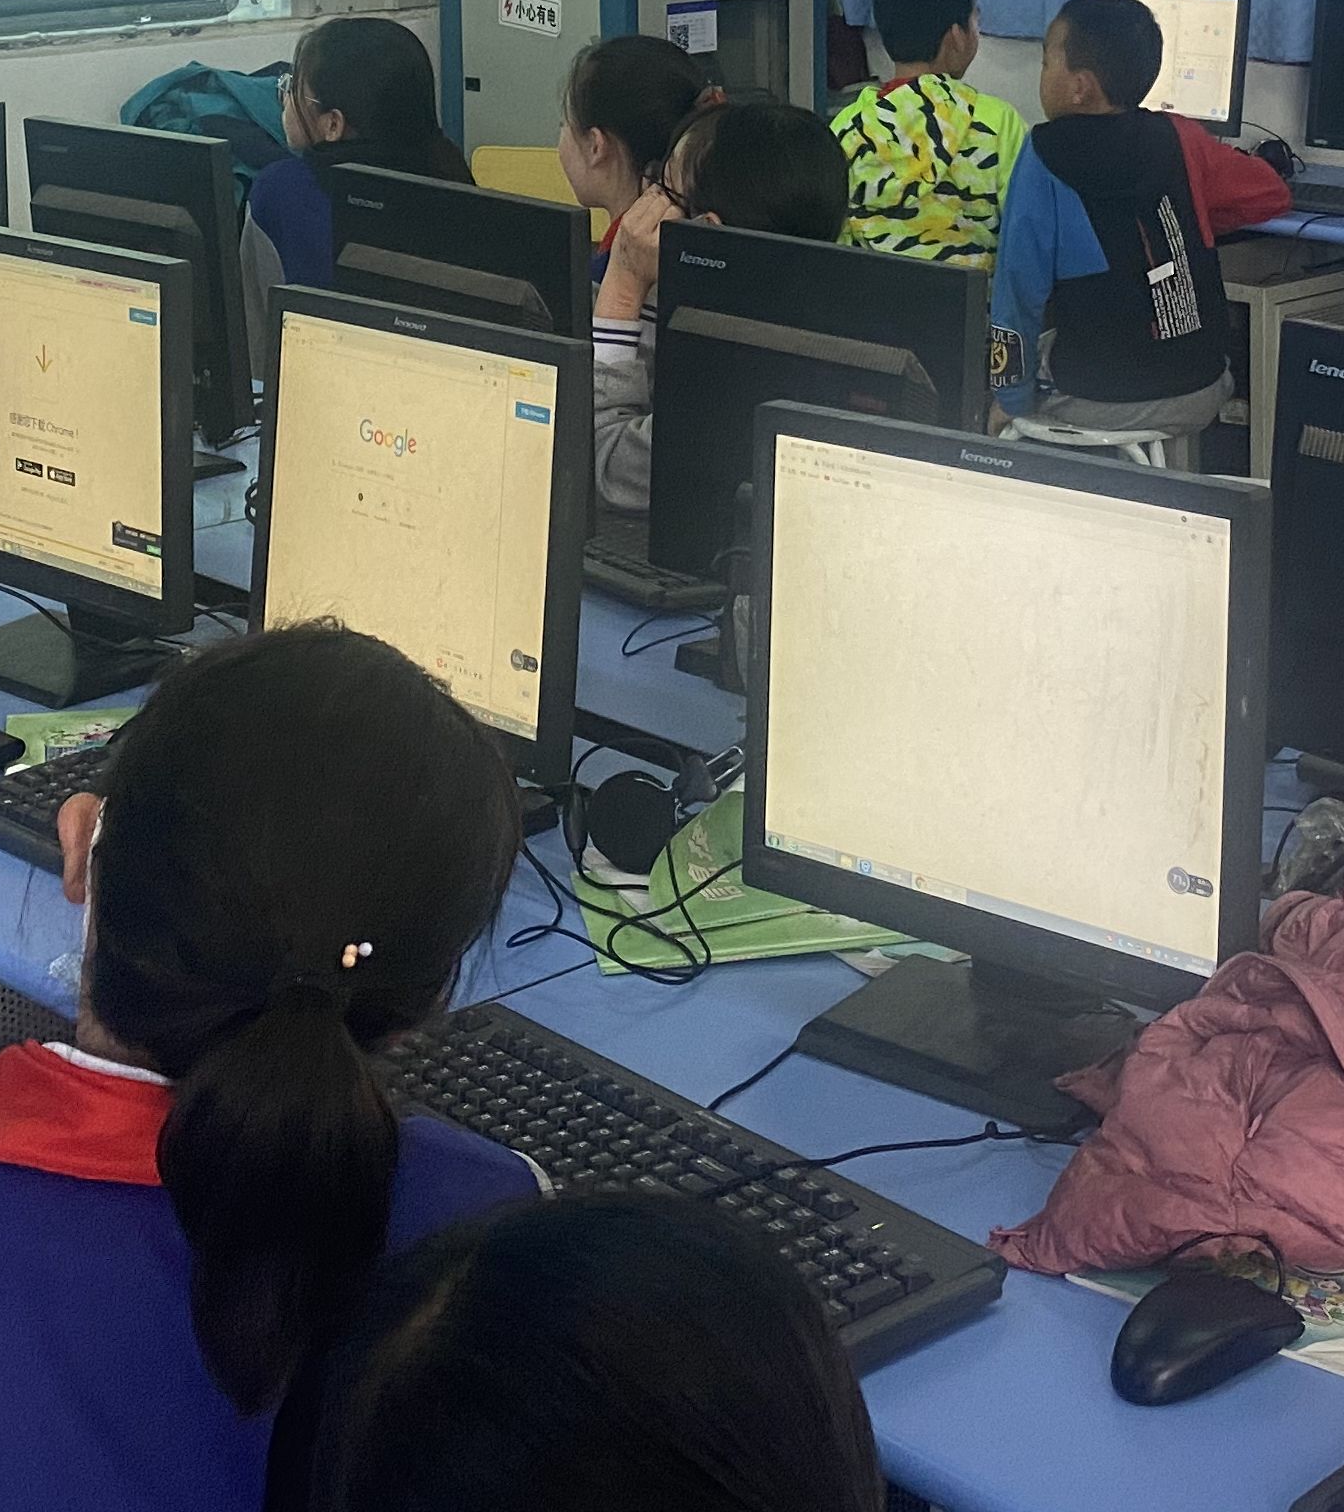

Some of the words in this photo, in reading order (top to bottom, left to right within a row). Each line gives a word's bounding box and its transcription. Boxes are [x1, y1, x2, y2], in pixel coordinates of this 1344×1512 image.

[515, 0, 556, 27] 小心有电
[348, 194, 384, 209] lenovo
[679, 251, 726, 268] lenovo
[394, 317, 427, 331] lenovo
[360, 419, 417, 457] Google
[960, 449, 1013, 469] lenovo
